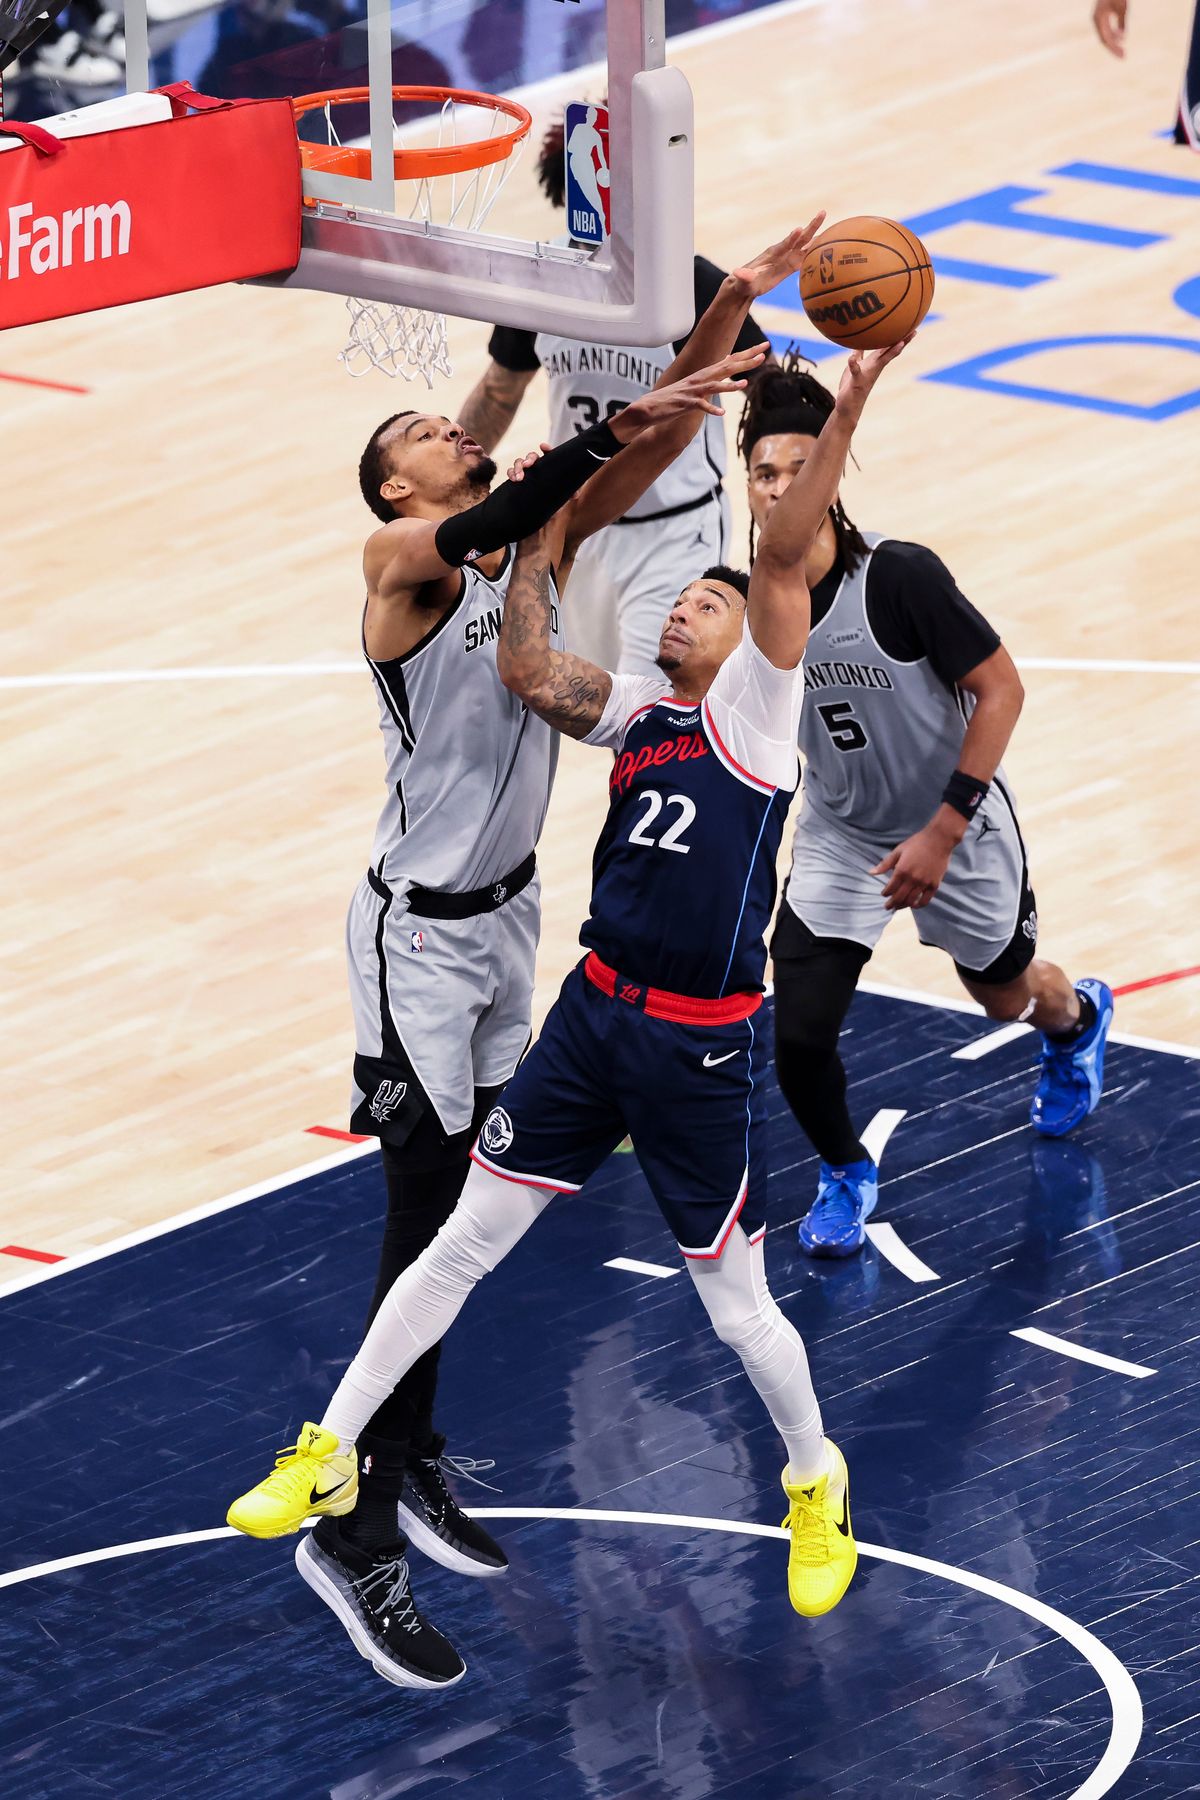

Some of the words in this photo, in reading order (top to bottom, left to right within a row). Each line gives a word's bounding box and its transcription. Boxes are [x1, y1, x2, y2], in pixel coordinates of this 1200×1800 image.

[0, 200, 132, 280] Farm
[573, 209, 597, 235] NBA
[464, 605, 502, 655] SAN
[832, 633, 859, 644] LEDGER
[816, 701, 868, 752] 5
[628, 789, 697, 854] 22
